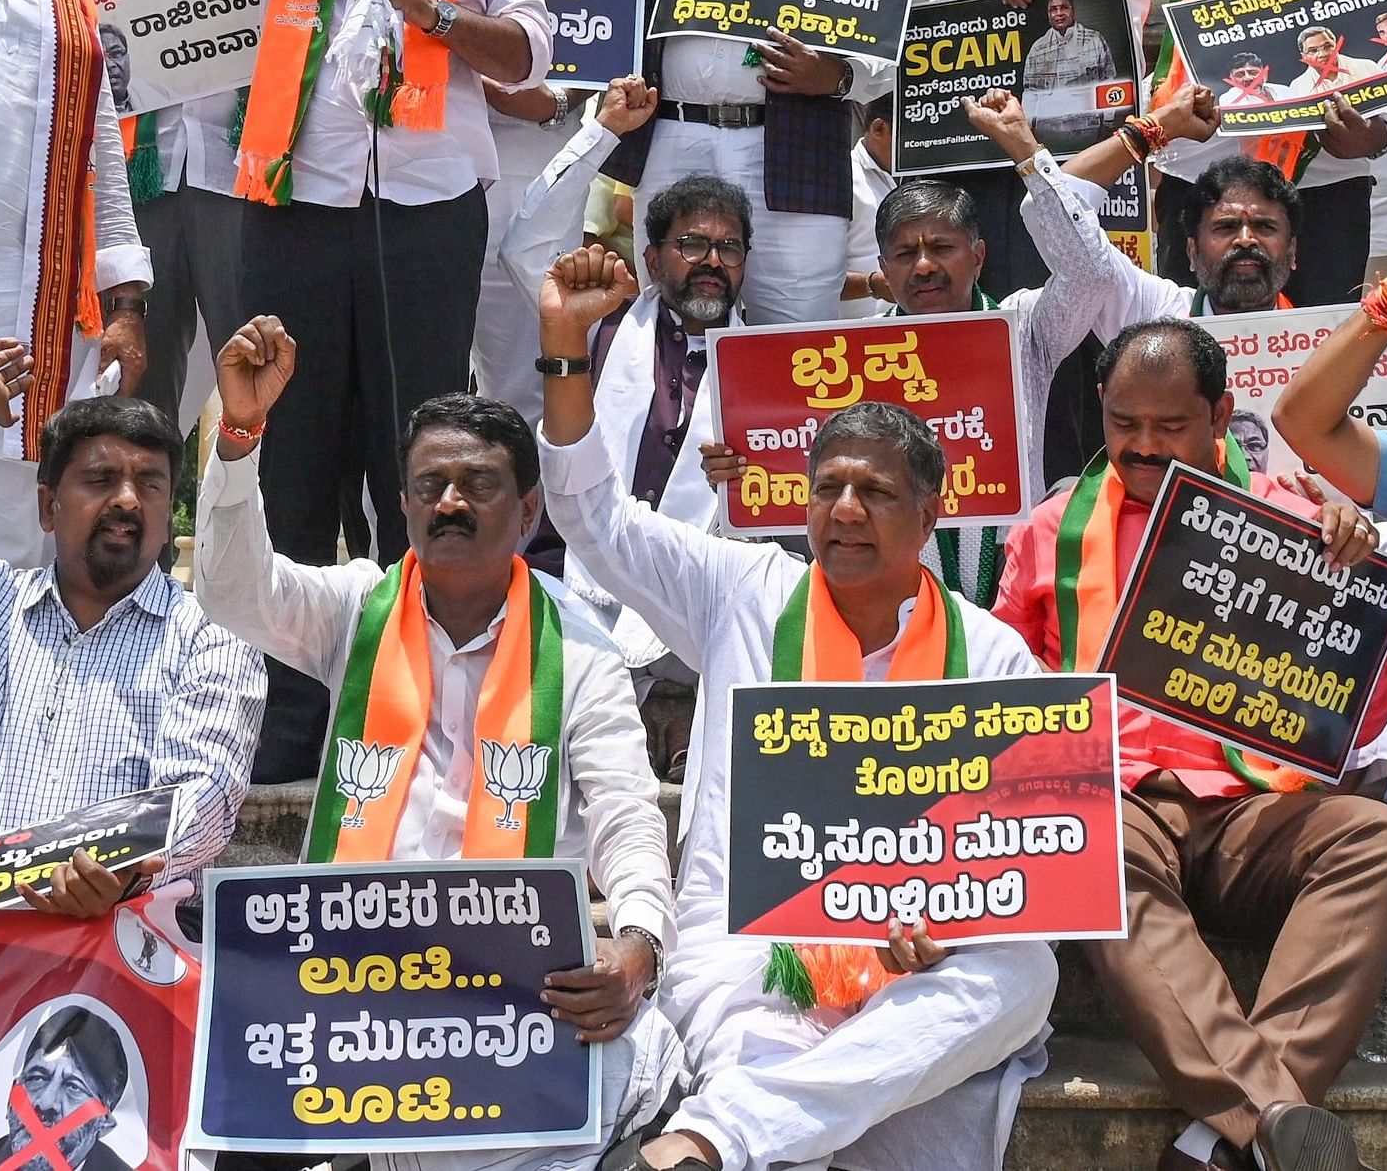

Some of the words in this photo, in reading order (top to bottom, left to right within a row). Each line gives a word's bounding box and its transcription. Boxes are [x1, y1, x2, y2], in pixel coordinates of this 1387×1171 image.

[776, 4, 877, 45] ಧಿಕ್ಕಾರ...
[904, 16, 989, 42] ಮಾಡೋದು
[1197, 28, 1247, 48] ಲೂಟಿ
[1249, 11, 1310, 39] ಸರ್ಕಾರ
[904, 30, 1023, 77] SCAM
[904, 133, 991, 149] #CongressFailsKarn
[791, 331, 939, 409] ಭ್ರಷ್ಟ
[1182, 560, 1266, 623] ಪತ್ನಿಗೆ
[1265, 594, 1299, 629] 14
[1299, 604, 1362, 658] ಸೈಟು
[1142, 610, 1205, 656] ಬಡ
[1202, 632, 1357, 715] ಮಹಿಳೆಯರಿಗೆ
[1163, 668, 1238, 716] ಖಾಲಿ
[753, 707, 828, 759] ಭ್ರಷ್ಟ
[829, 704, 967, 752] ಕಾಂಗ್ರೆಸ್
[973, 697, 1092, 739] ಸರ್ಕಾರ
[855, 756, 991, 796] ತೊಲಗಲಿ
[762, 811, 944, 881] ಮೈಸೂರು
[954, 812, 1086, 862] ಮುಡಾ
[245, 883, 314, 953] ಅತ್ತ
[320, 878, 439, 931] ದಲಿತರ
[448, 877, 551, 947] ದುಡ್ಡು
[822, 871, 1026, 926] ಉಳಿಯಲಿ
[299, 945, 503, 994] ಲೂಟಿ...
[245, 1012, 319, 1086] ಇತ್ತ
[327, 1004, 556, 1067] ಮುಡಾವೂ
[292, 1076, 503, 1126] ಲೂಟಿ...
